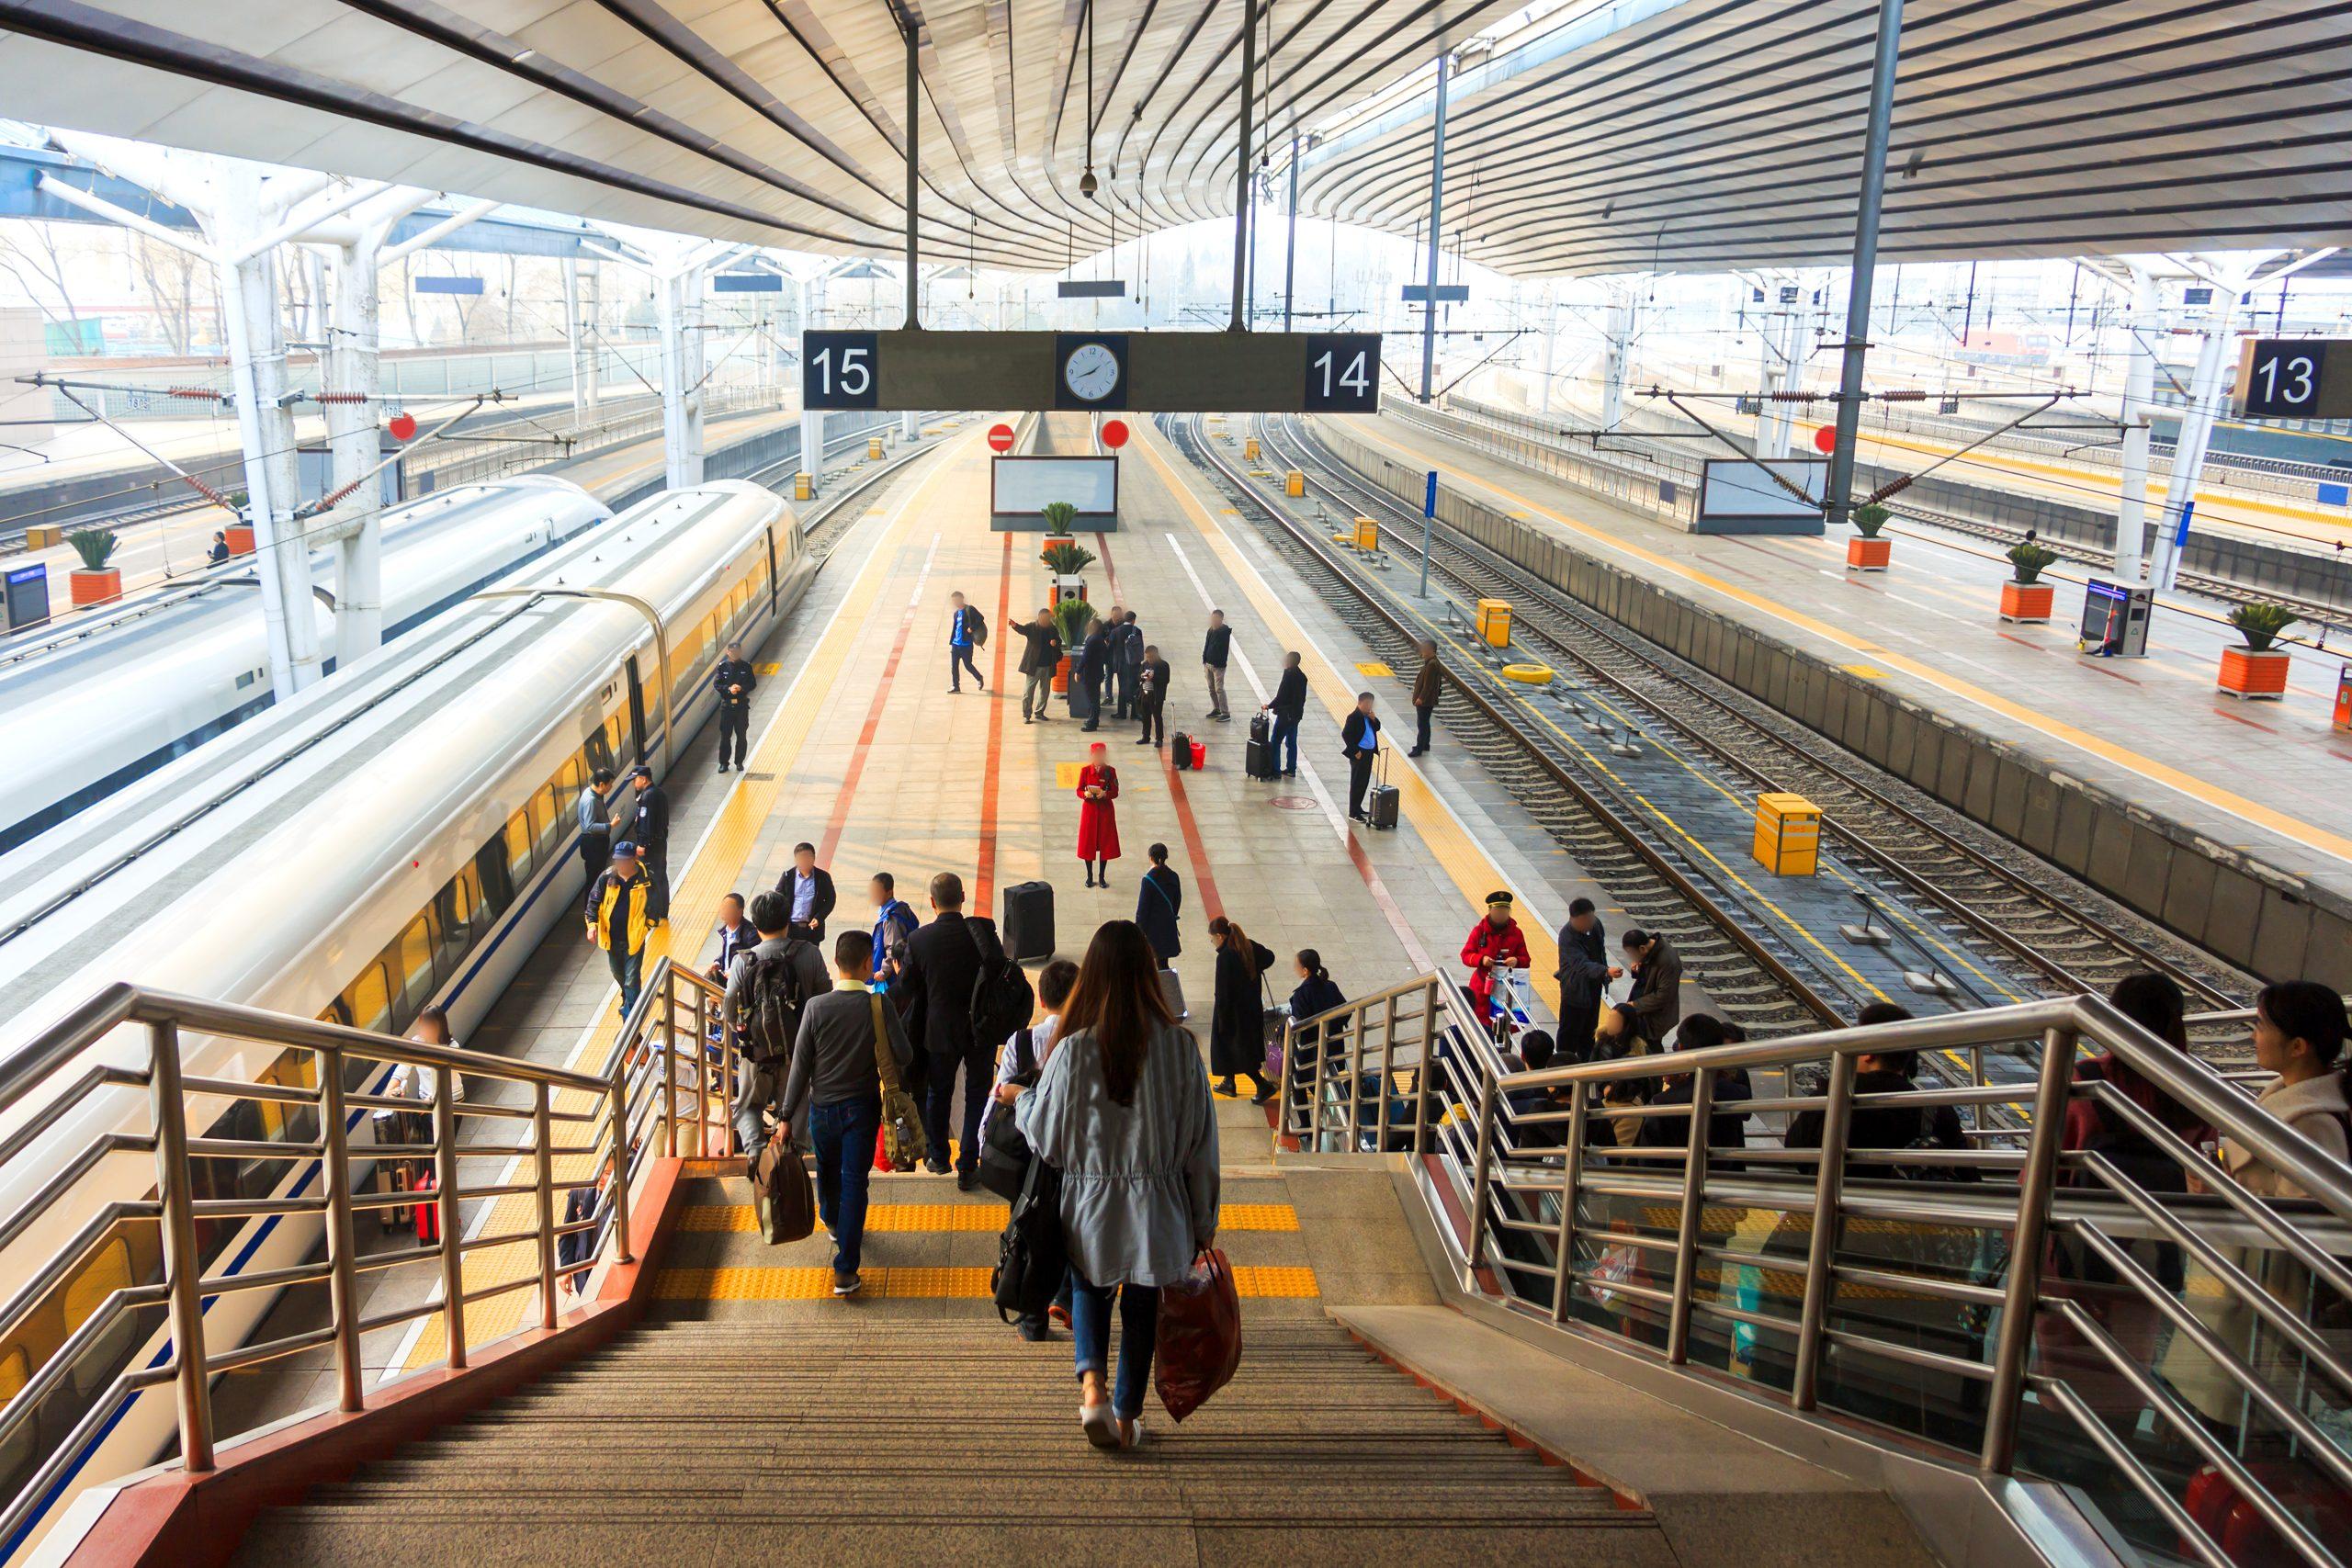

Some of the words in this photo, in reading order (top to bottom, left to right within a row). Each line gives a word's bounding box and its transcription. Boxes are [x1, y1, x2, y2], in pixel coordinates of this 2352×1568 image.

[812, 347, 870, 395] 15
[1089, 347, 1096, 355] 12
[1314, 350, 1370, 398] 14
[2258, 356, 2313, 403] 13
